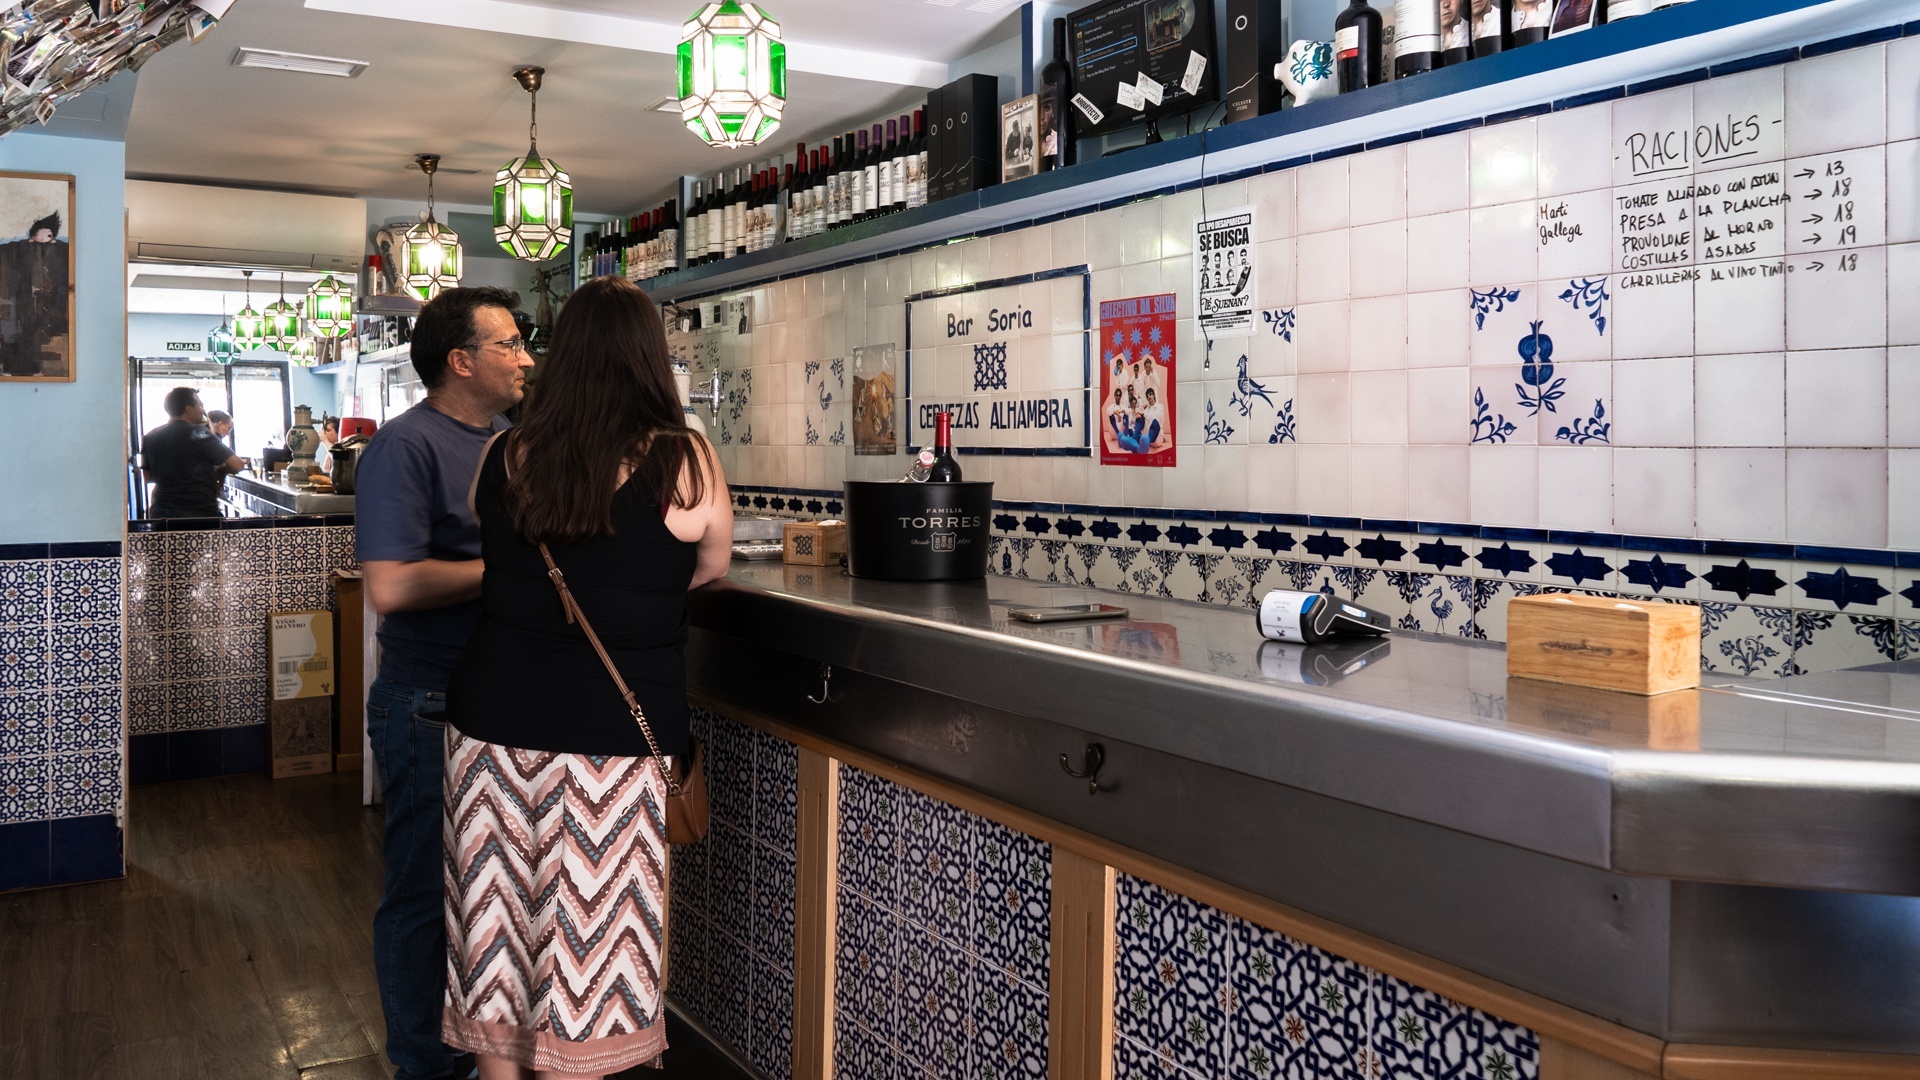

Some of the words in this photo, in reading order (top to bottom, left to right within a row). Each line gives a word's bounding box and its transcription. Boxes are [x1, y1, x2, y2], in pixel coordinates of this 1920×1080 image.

[1076, 98, 1100, 120] ARQUITECTO
[1232, 99, 1252, 107] CELESTE
[1728, 177, 1746, 192] CON
[1826, 160, 1845, 177] 13
[1620, 213, 1665, 234] PRESA
[1698, 204, 1713, 217] LA
[1723, 192, 1792, 214] PLANCHA
[1832, 177, 1852, 198] 18
[1200, 234, 1212, 252] SE
[1214, 227, 1249, 249] BUSCA
[1622, 231, 1690, 253] PROVOLONE
[1834, 200, 1854, 222] 18
[1622, 249, 1688, 270] COSTILLAS
[1705, 242, 1756, 260] ASADAS
[1838, 225, 1857, 244] 19
[1621, 269, 1701, 289] CARRILLERAS
[1838, 253, 1858, 272] 18
[947, 313, 973, 337] Bar
[988, 304, 1032, 332] Soria
[1101, 300, 1137, 319] COLECTIVO
[1140, 298, 1150, 314] DA
[1154, 295, 1175, 313] SILVA
[990, 398, 1072, 429] ALHAMBRA
[898, 516, 980, 528] TORRES
